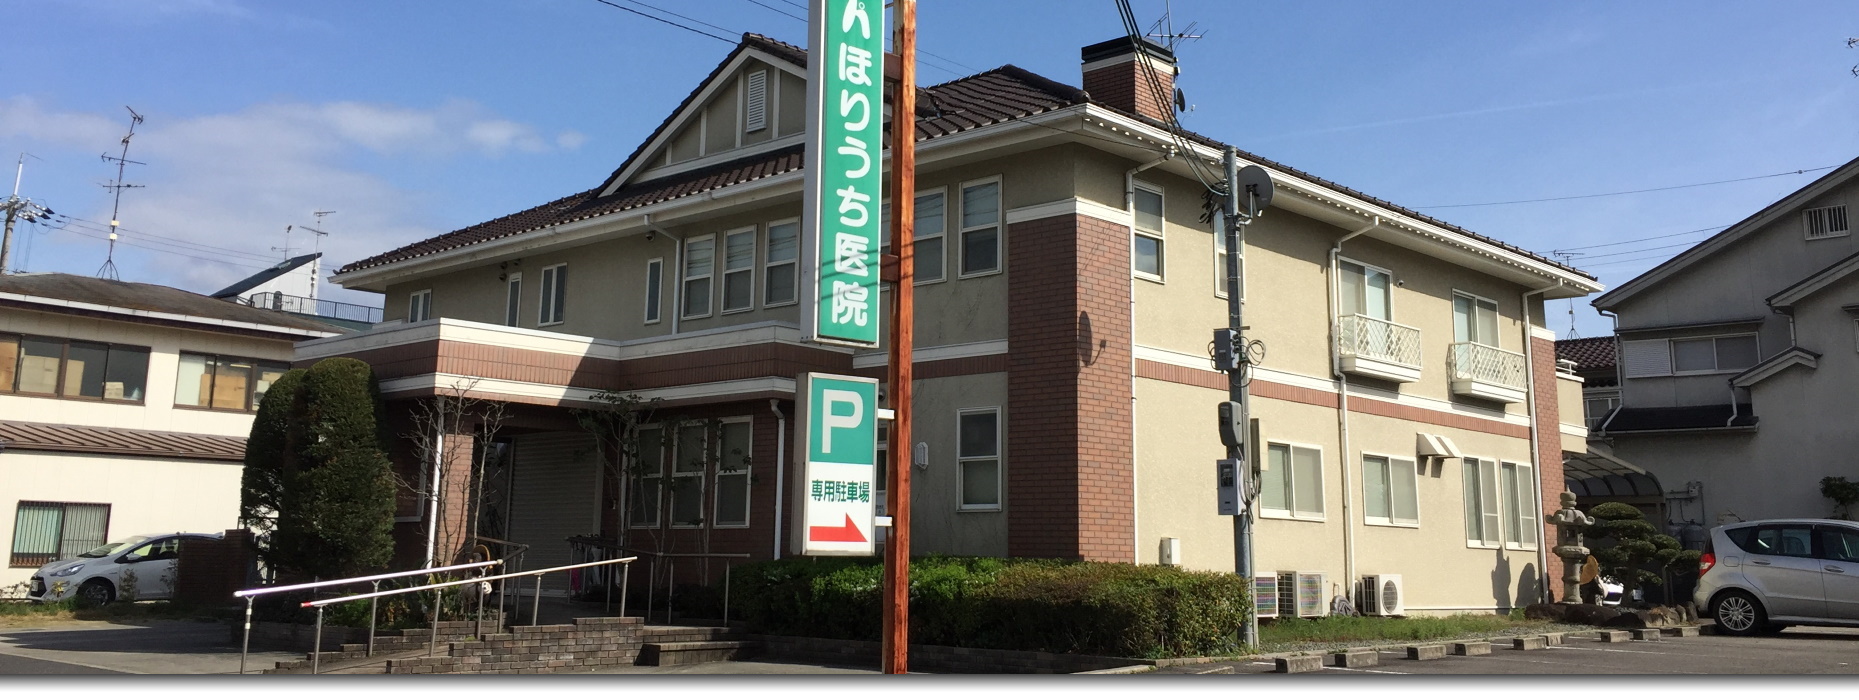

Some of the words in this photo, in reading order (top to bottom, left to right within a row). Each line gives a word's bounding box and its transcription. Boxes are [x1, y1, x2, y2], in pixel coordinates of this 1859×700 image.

[832, 43, 873, 327] ほりうち医院
[821, 388, 864, 454] P
[811, 479, 870, 503] 専用駐車場
